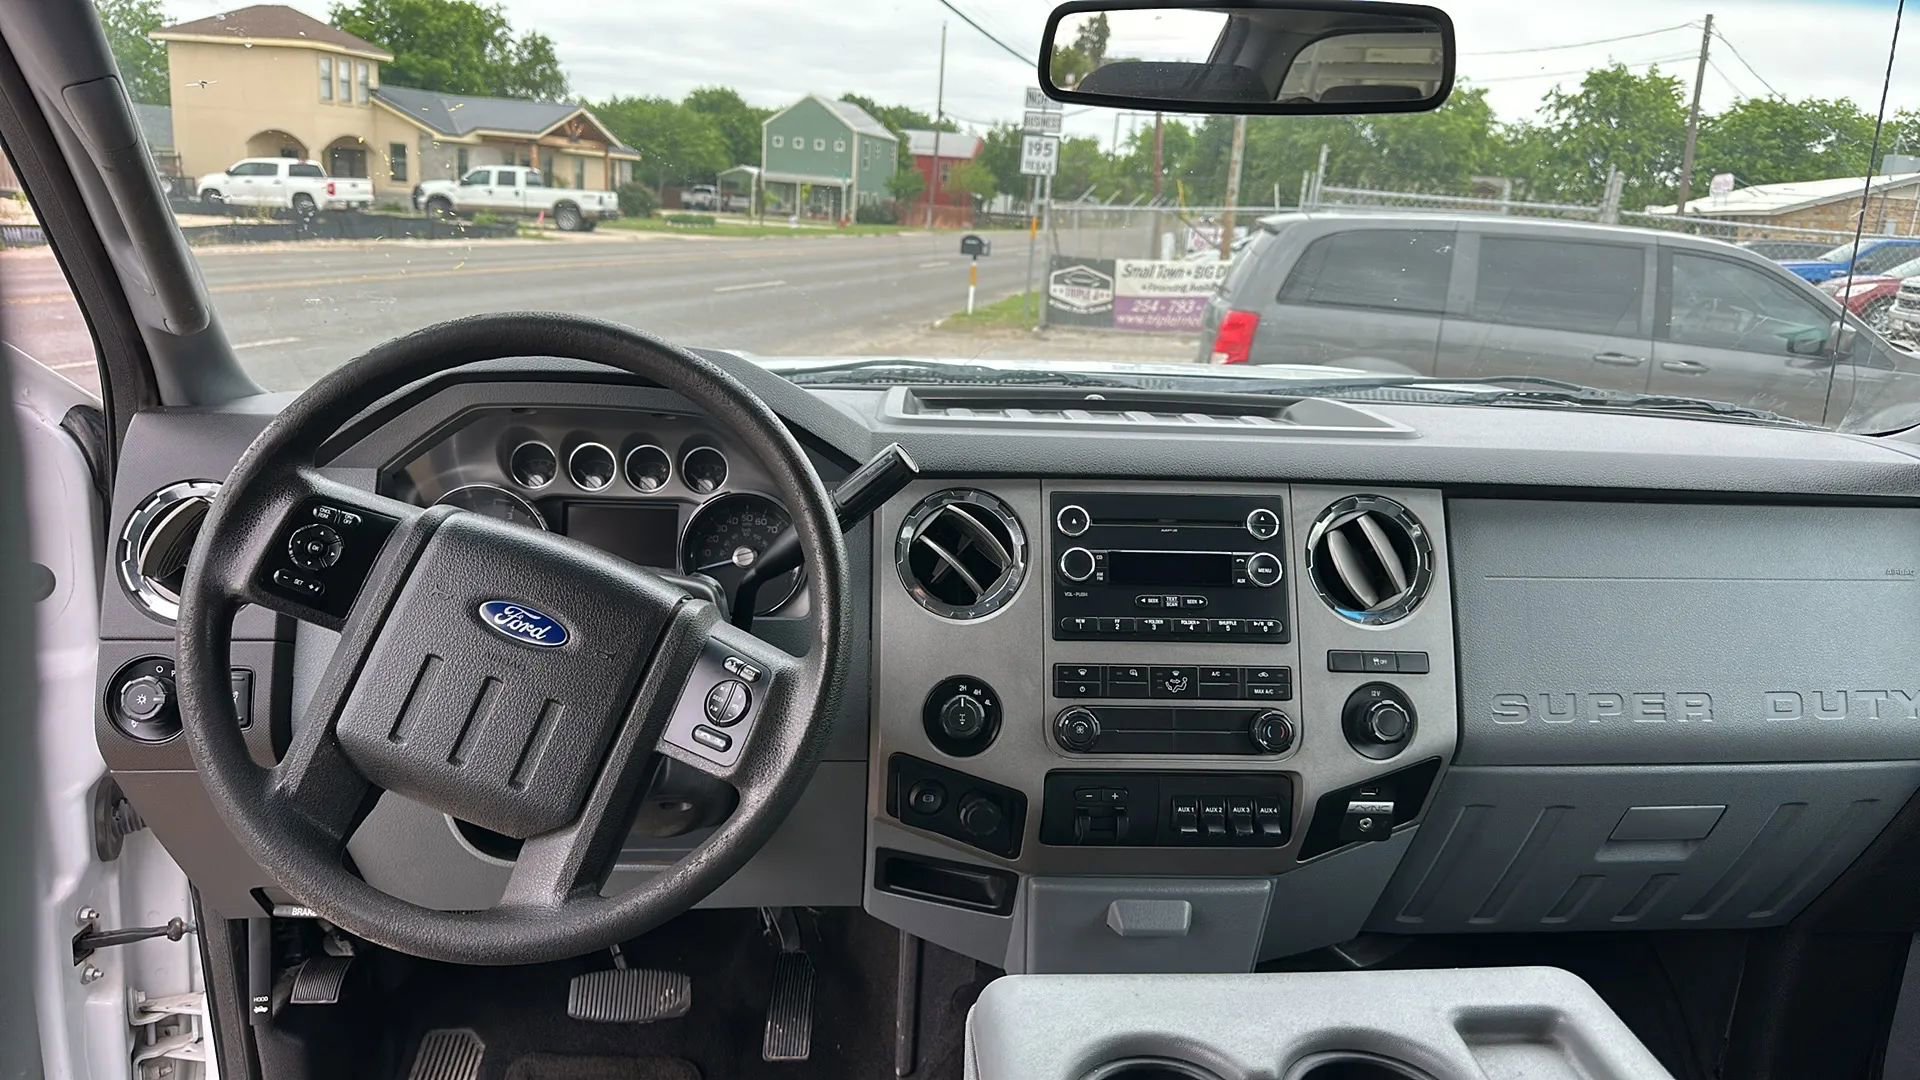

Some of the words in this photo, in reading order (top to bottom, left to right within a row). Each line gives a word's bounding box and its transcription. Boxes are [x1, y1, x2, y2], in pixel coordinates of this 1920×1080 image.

[1028, 142, 1053, 157] 195
[1121, 264, 1154, 278] Small
[1156, 264, 1186, 278] Town
[1194, 265, 1215, 279] BIG
[767, 525, 778, 534] 70
[293, 578, 304, 586] SET
[494, 606, 552, 640] Ford
[1491, 691, 1714, 725] SUPER
[1765, 690, 1920, 721] DUTY
[1350, 803, 1392, 813] SYNC
